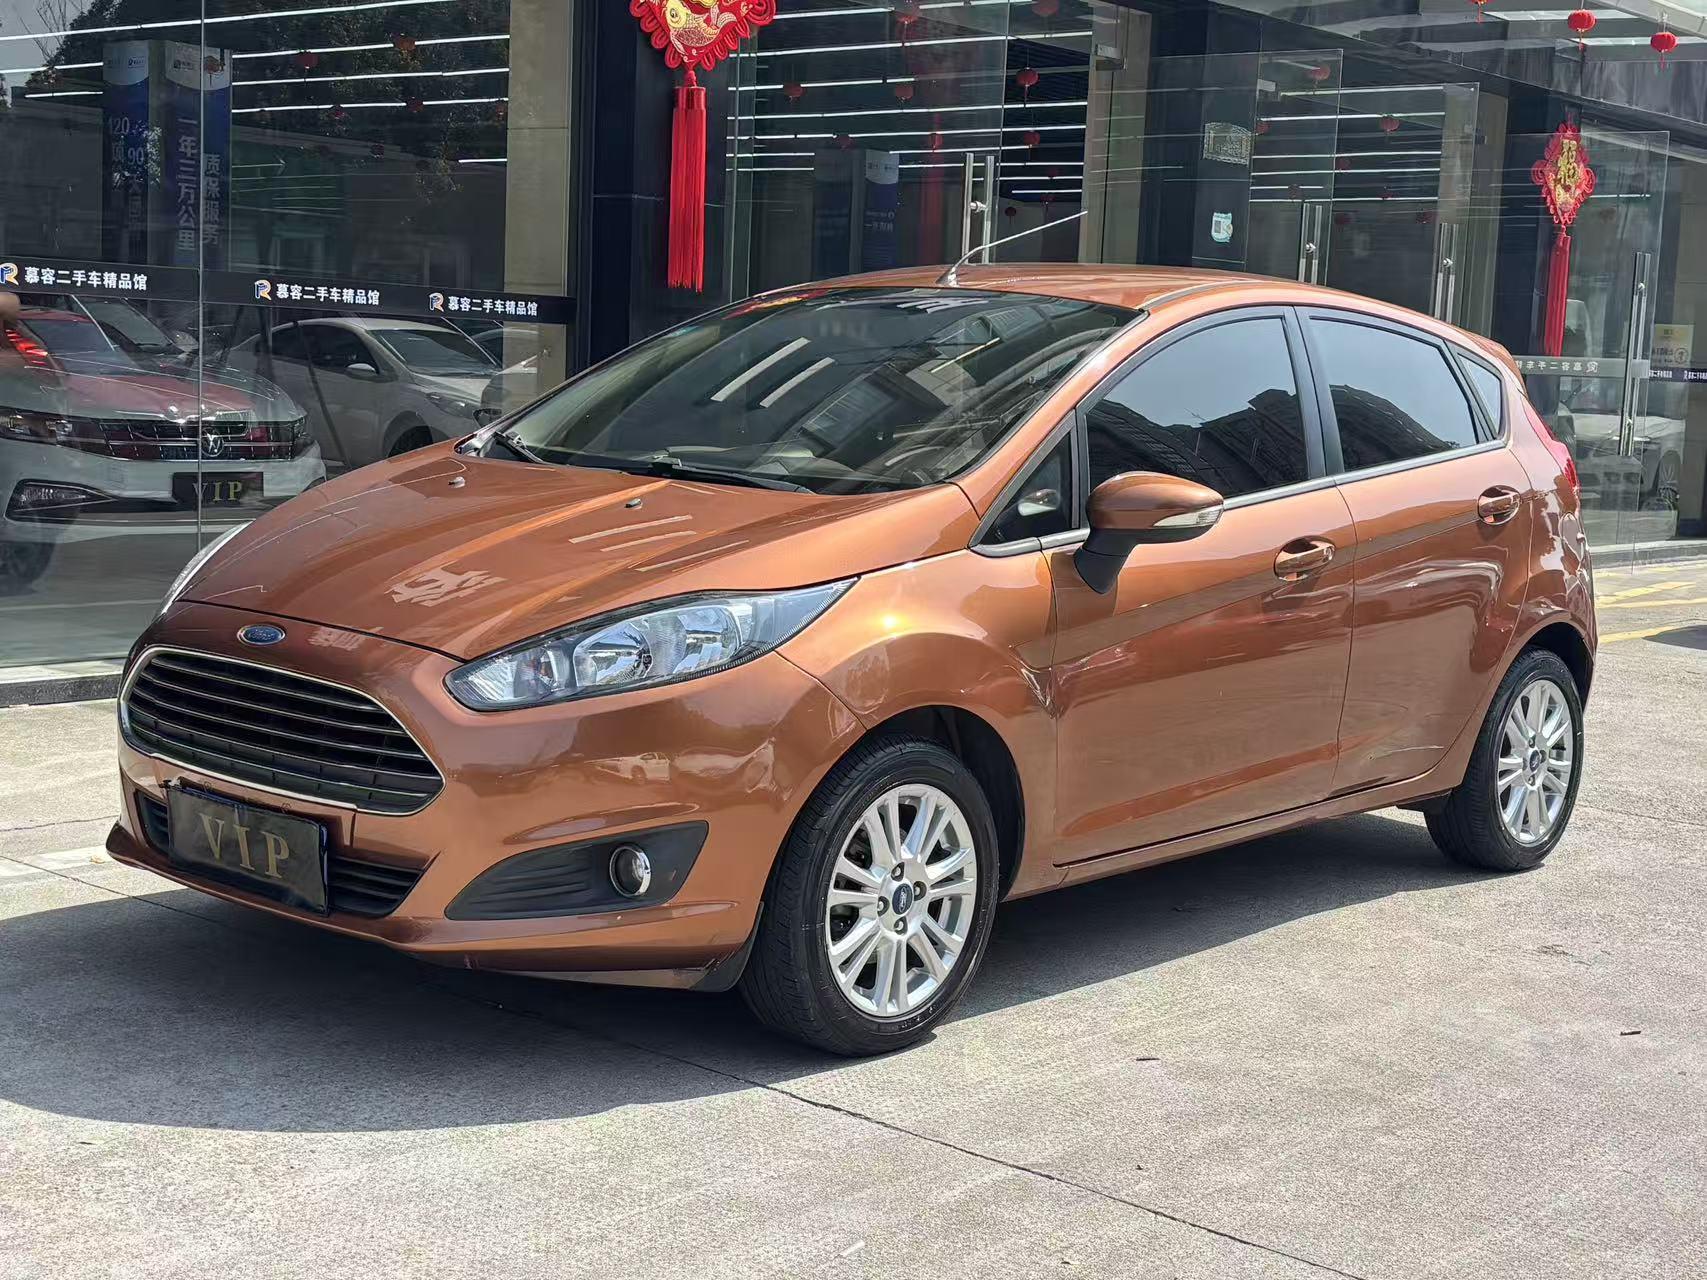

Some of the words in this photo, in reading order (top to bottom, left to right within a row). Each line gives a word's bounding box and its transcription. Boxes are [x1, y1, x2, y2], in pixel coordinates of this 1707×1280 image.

[24, 266, 148, 291] 慕容二手车精品馆
[276, 283, 380, 305] 慕容二手车精品馆
[447, 295, 538, 317] 慕容二手车精品馆
[192, 481, 243, 501] VIP
[200, 812, 290, 879] VIP
